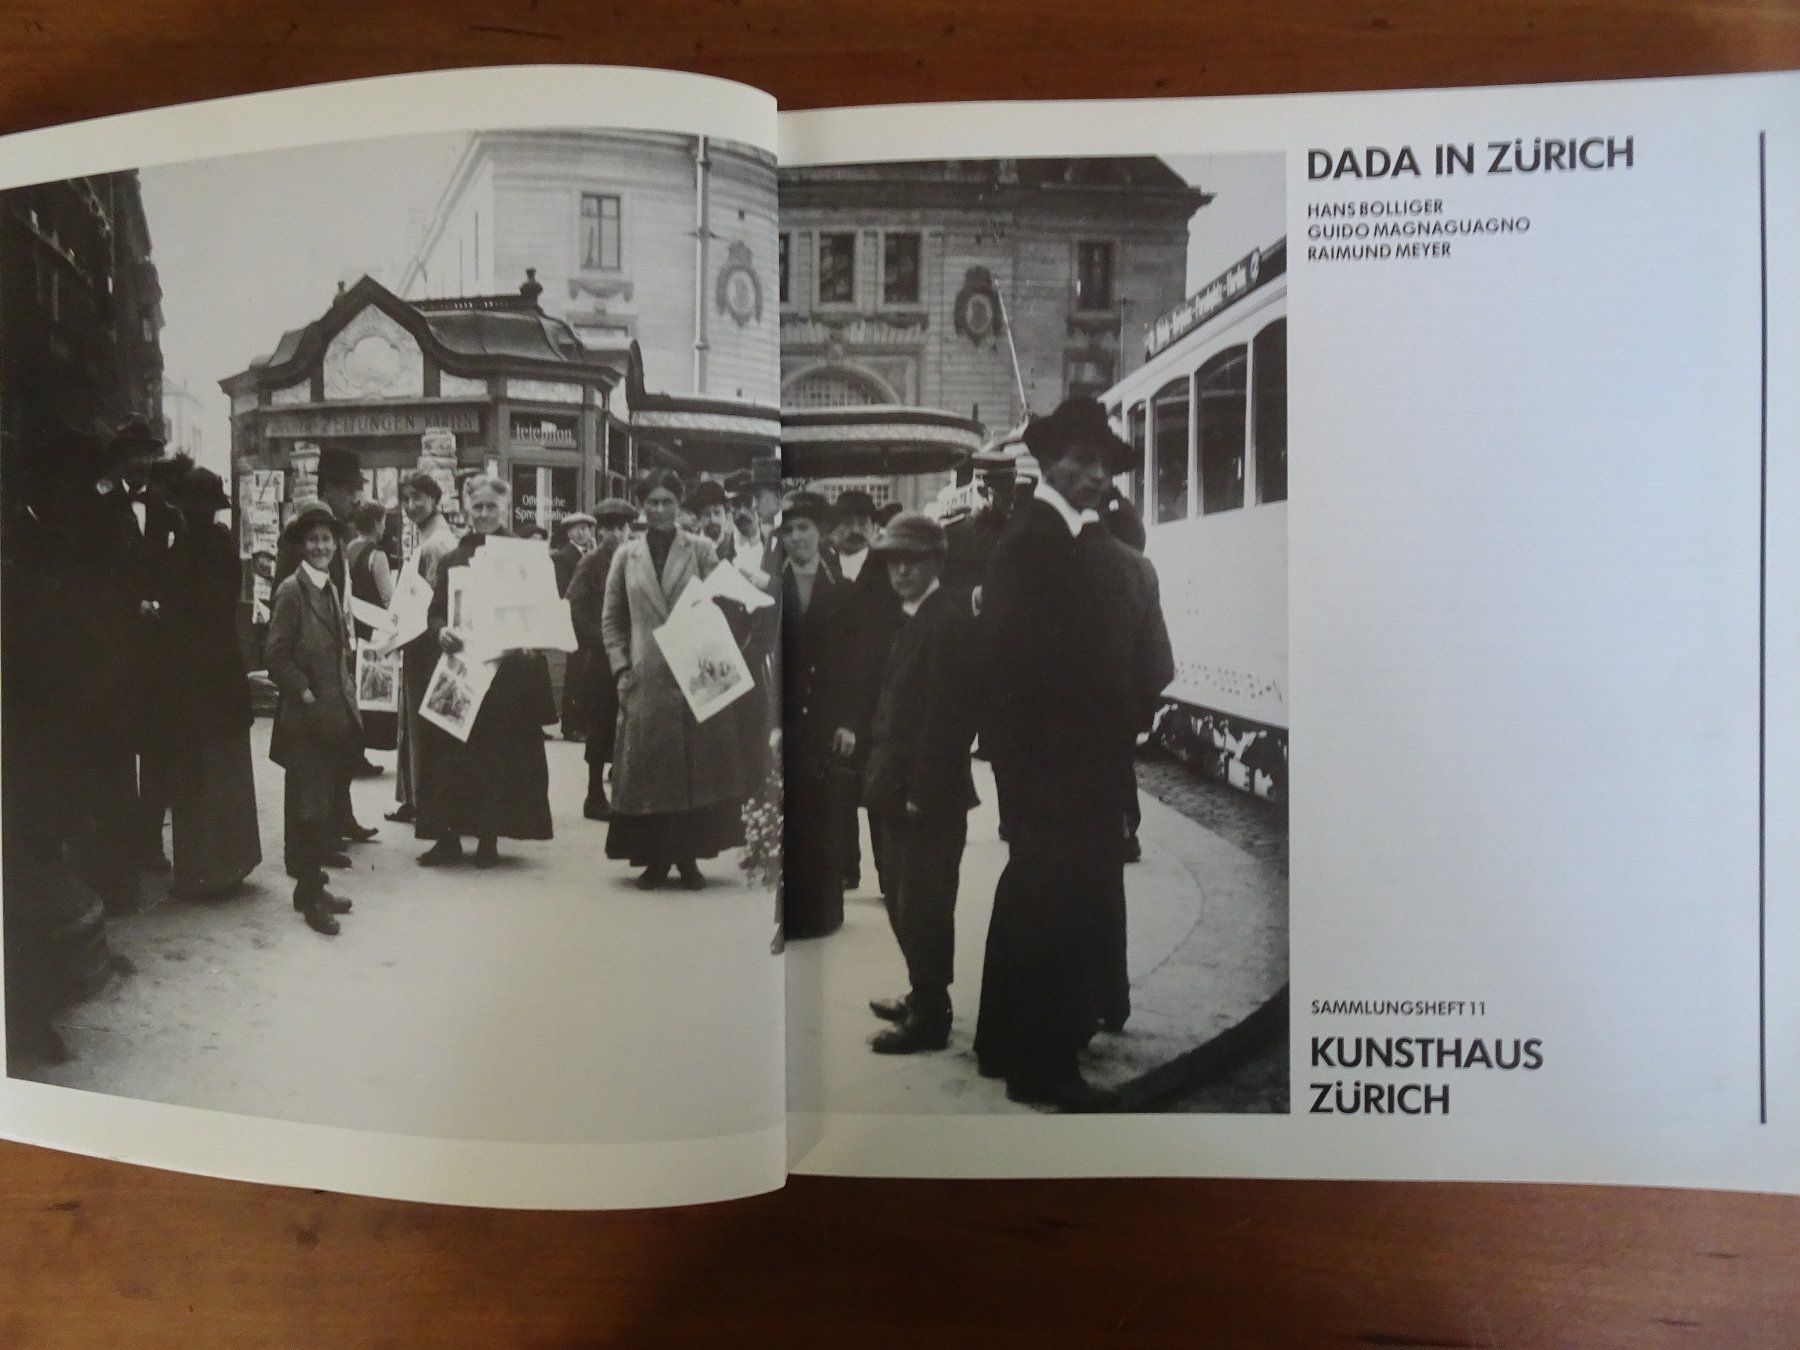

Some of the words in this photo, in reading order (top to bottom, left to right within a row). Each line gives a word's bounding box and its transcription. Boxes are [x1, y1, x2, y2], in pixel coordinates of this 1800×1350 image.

[1308, 145, 1422, 182] DADA
[1435, 143, 1474, 177] IN
[1487, 135, 1634, 175] ZÜRICH
[1308, 202, 1355, 219] HANS
[1360, 199, 1443, 217] BOLLIGER
[1308, 223, 1369, 241] GUIDO
[1373, 216, 1530, 238] MAGNAGUAGNO
[1308, 243, 1391, 262] RAIMUND
[1396, 241, 1451, 259] MEYER
[1311, 999, 1465, 1016] SAMMLUNGSHEFT
[1470, 1001, 1485, 1016] 11
[1311, 1035, 1544, 1070] KUNSTHAUS
[1309, 1080, 1450, 1116] ZÜRICH
